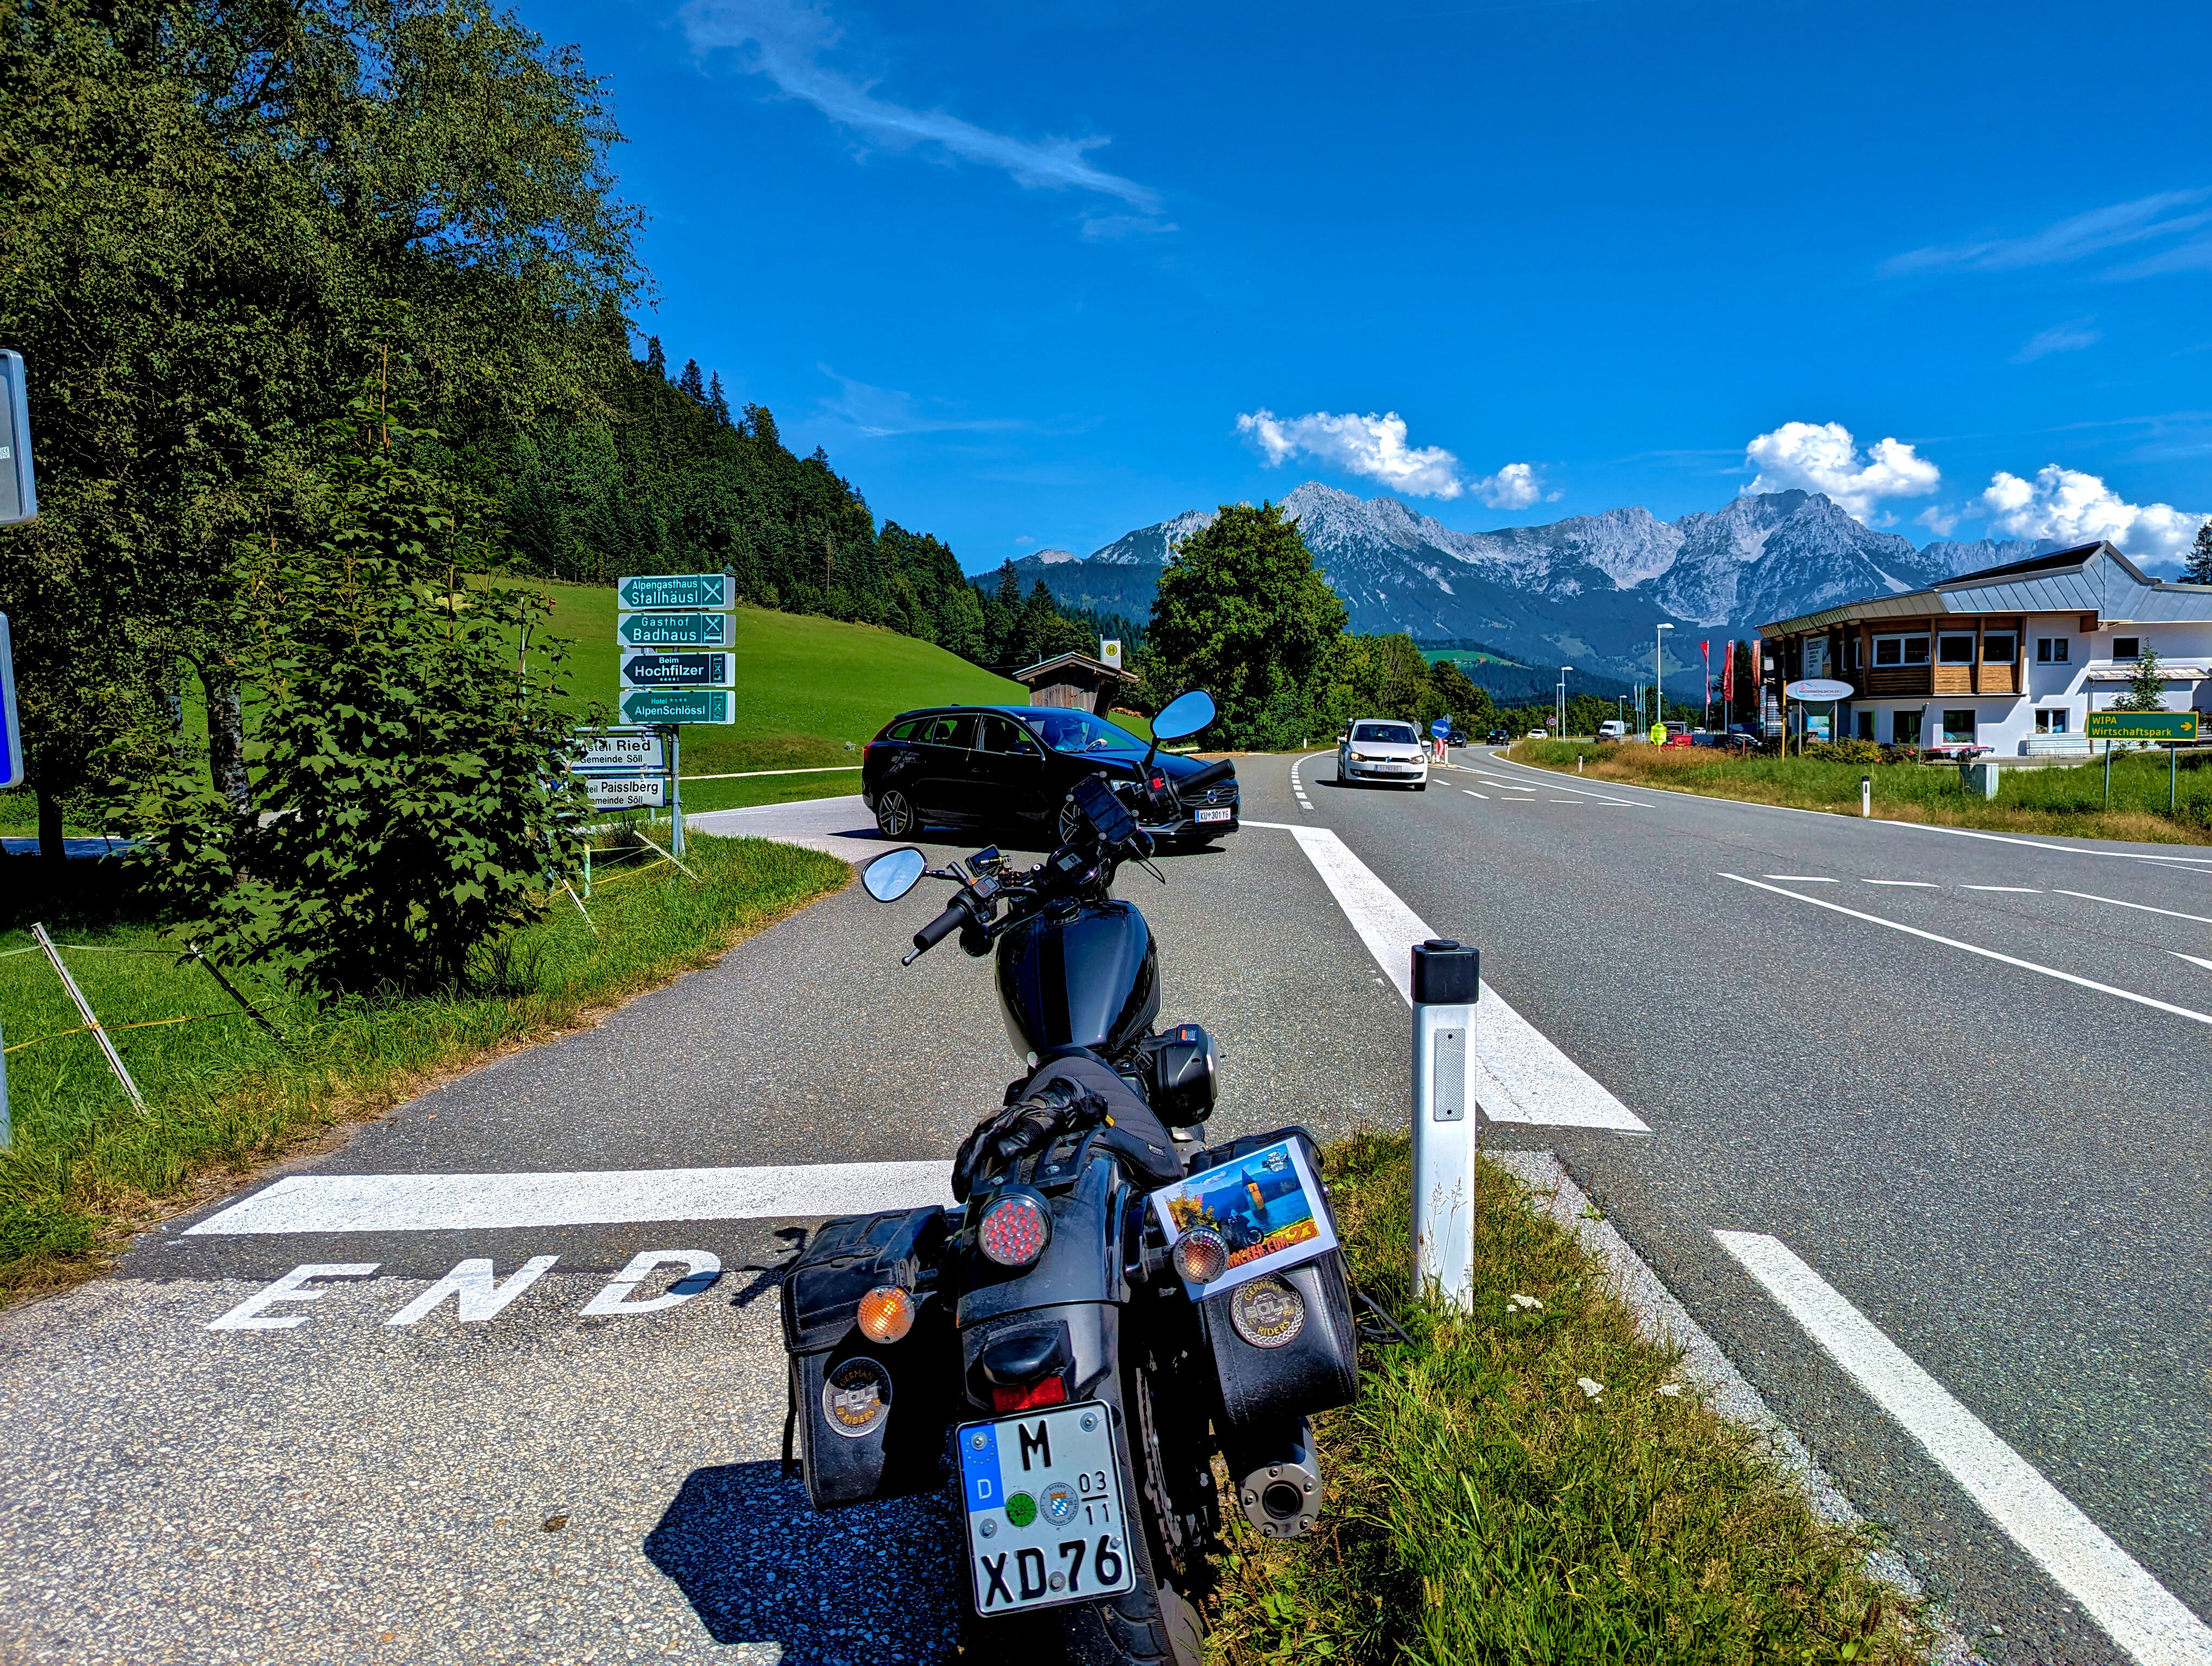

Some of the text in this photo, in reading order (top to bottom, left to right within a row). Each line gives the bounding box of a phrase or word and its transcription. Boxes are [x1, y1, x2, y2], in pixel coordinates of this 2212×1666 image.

[632, 579, 698, 591] Alpengasthaus
[632, 590, 698, 605] Stallhäusl
[641, 617, 689, 626] Gasthof
[633, 628, 697, 641] Badhaus
[1109, 646, 1115, 654] H
[635, 664, 704, 677] Hochfilzer
[634, 705, 705, 717] AlpenSchlössl
[2092, 716, 2117, 725] WIPA
[2092, 727, 2172, 738] Wirtschaftspark
[616, 740, 651, 751] Ried
[580, 754, 643, 764] Gemeinde Söll
[601, 781, 659, 794] Paisslberg
[627, 796, 643, 804] Söll
[1200, 810, 1229, 821] KU 301 YG
[1244, 1281, 1283, 1301] GERMAN
[1244, 1297, 1290, 1319] BOLT
[1257, 1319, 1290, 1336] RIDERS
[840, 1369, 874, 1386] GERMAN
[834, 1386, 882, 1407] BOLT
[843, 1408, 876, 1425] RIDERS
[1019, 1419, 1052, 1471] M
[1079, 1470, 1107, 1493] 03
[977, 1479, 992, 1499] D
[1085, 1502, 1109, 1525] 11
[981, 1533, 1123, 1607] XD 76
